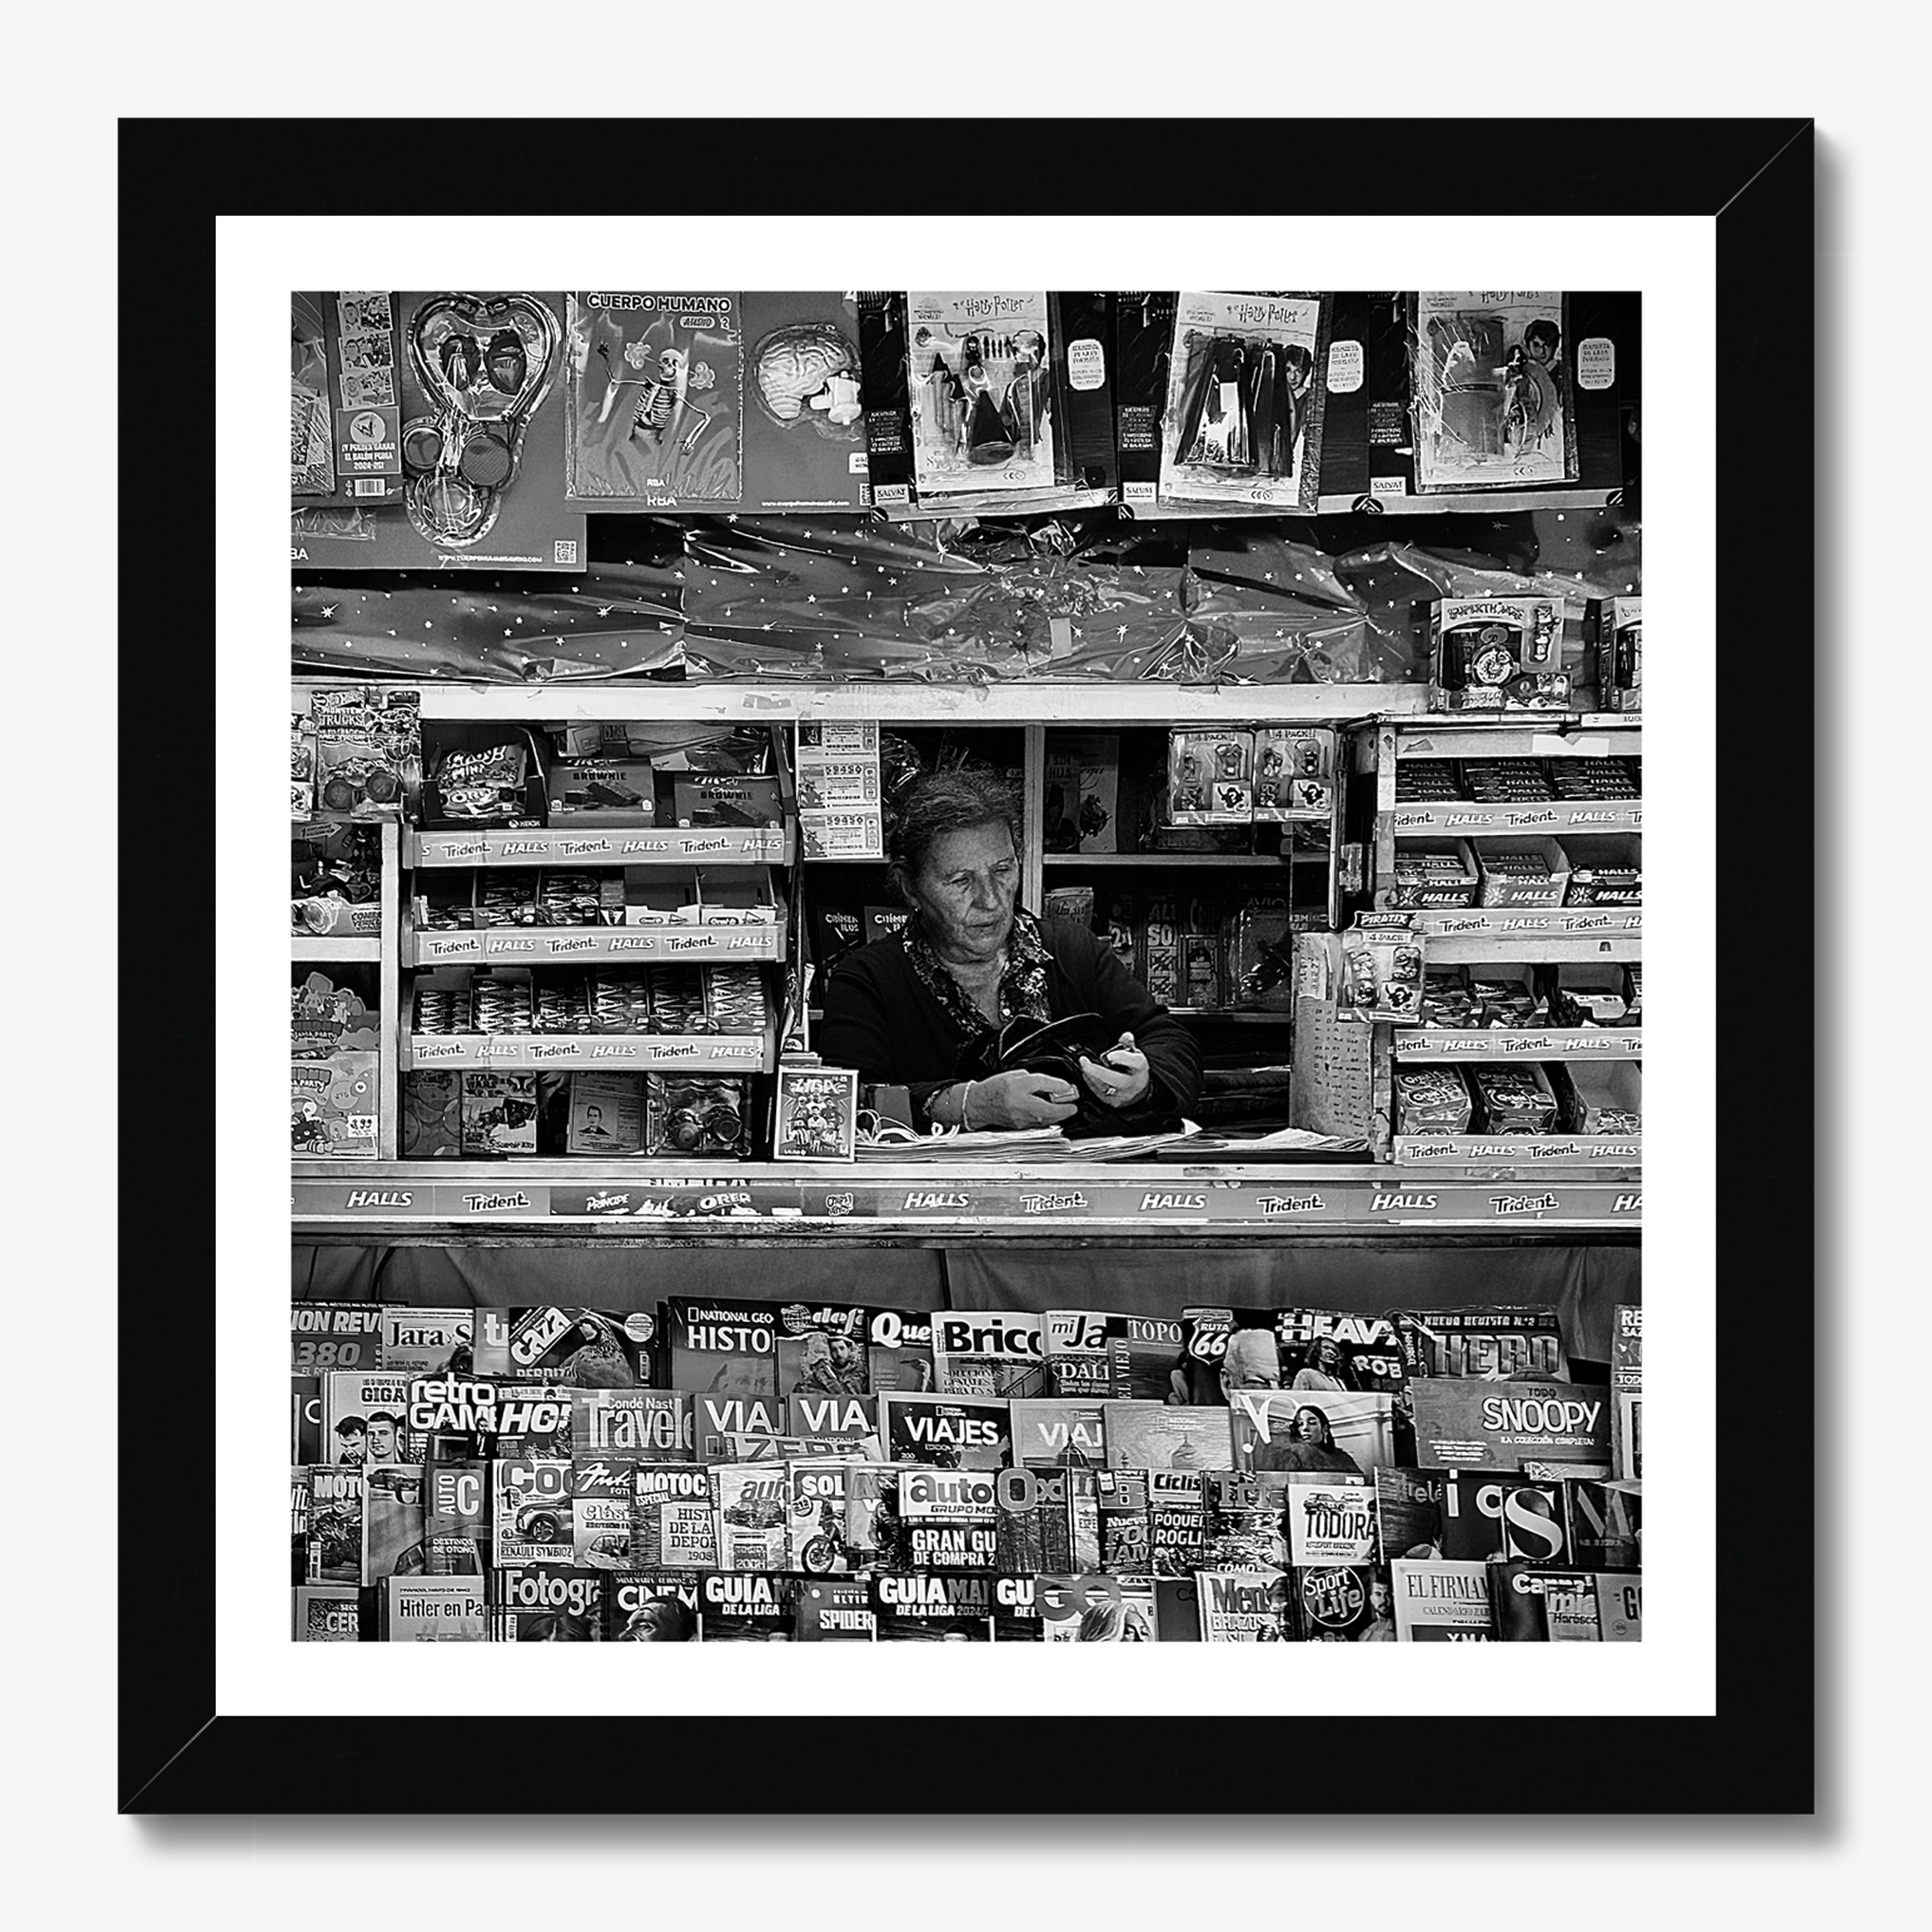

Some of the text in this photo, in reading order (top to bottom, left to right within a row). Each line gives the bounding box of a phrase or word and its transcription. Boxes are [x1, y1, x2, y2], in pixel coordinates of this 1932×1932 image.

[587, 294, 732, 313] CUERPO HUMANO
[646, 495, 677, 507] RBA
[1445, 813, 1495, 827] HALLS
[1505, 809, 1560, 825] Trident
[1568, 811, 1617, 825] HALLS
[442, 842, 492, 858] Trident
[502, 842, 549, 855] HALLS
[560, 838, 613, 855] Trident
[621, 840, 669, 854] HALLS
[680, 837, 732, 854] Trident
[740, 838, 783, 852] HALLS
[1420, 893, 1469, 903] HALLS
[1510, 890, 1559, 901] HALLS
[1595, 890, 1641, 901] HALLS
[1360, 913, 1407, 925] PIRATIX
[1439, 916, 1490, 933] Trident
[1501, 917, 1548, 931] HALLS
[1561, 914, 1612, 932] Trident
[429, 935, 772, 956] Trident HALLS Trident HALLS Trident HALLS
[413, 1043, 756, 1060] Trident HALLS Trident HALLS Trident HALLS
[1397, 1036, 1611, 1053] dent HALLS Trident HALLS
[1406, 1142, 1638, 1158] Trident HALLS Trident HALLS
[347, 1190, 752, 1212] HALLS Trident OREO
[903, 1192, 970, 1210] HALLS
[1019, 1192, 1087, 1214] Trident
[1138, 1193, 1207, 1212] HALLS
[1257, 1194, 1326, 1216] Trident
[1369, 1194, 1438, 1213] HALLS
[1488, 1193, 1560, 1216] Trident
[699, 1308, 750, 1324] NATIONAL
[1051, 1318, 1074, 1334] mi
[386, 1319, 446, 1348] Jara
[1128, 1318, 1183, 1343] TOPO
[1199, 1322, 1230, 1332] RUTA
[687, 1325, 774, 1353] HISTO
[1194, 1332, 1229, 1355] 66
[291, 1341, 362, 1366] 380
[1432, 1335, 1562, 1375] HERO
[1352, 1355, 1403, 1379] ROB
[410, 1372, 495, 1405] retro
[1526, 1388, 1556, 1398] TODO
[607, 1396, 674, 1410] Condé Nast
[1481, 1396, 1601, 1434] SNOOPY
[903, 1416, 999, 1446] VIAJES
[636, 1471, 708, 1497] MOTOC
[910, 1474, 994, 1504] auto
[1154, 1473, 1202, 1492] Ciclis
[437, 1474, 456, 1515] AUTO
[456, 1475, 479, 1516] C
[930, 1505, 974, 1515] GRUPO
[669, 1522, 712, 1534] DE LA
[1504, 1486, 1564, 1561] S
[911, 1529, 997, 1553] GRAN GU
[913, 1552, 930, 1566] DE
[932, 1552, 986, 1566] COMPRA
[705, 1573, 773, 1604] GUÍA
[879, 1573, 947, 1604] GUÍA
[996, 1578, 1035, 1606] GU
[1304, 1568, 1351, 1597] Sport
[1406, 1574, 1428, 1598] EL
[399, 1598, 485, 1617] Hitler en Pa
[721, 1604, 736, 1615] DE
[753, 1604, 781, 1616] LIGA
[896, 1604, 956, 1617] DE LA LIGA
[1014, 1606, 1029, 1617] DE
[1315, 1583, 1364, 1619] Life
[819, 1609, 874, 1631] SPIDER
